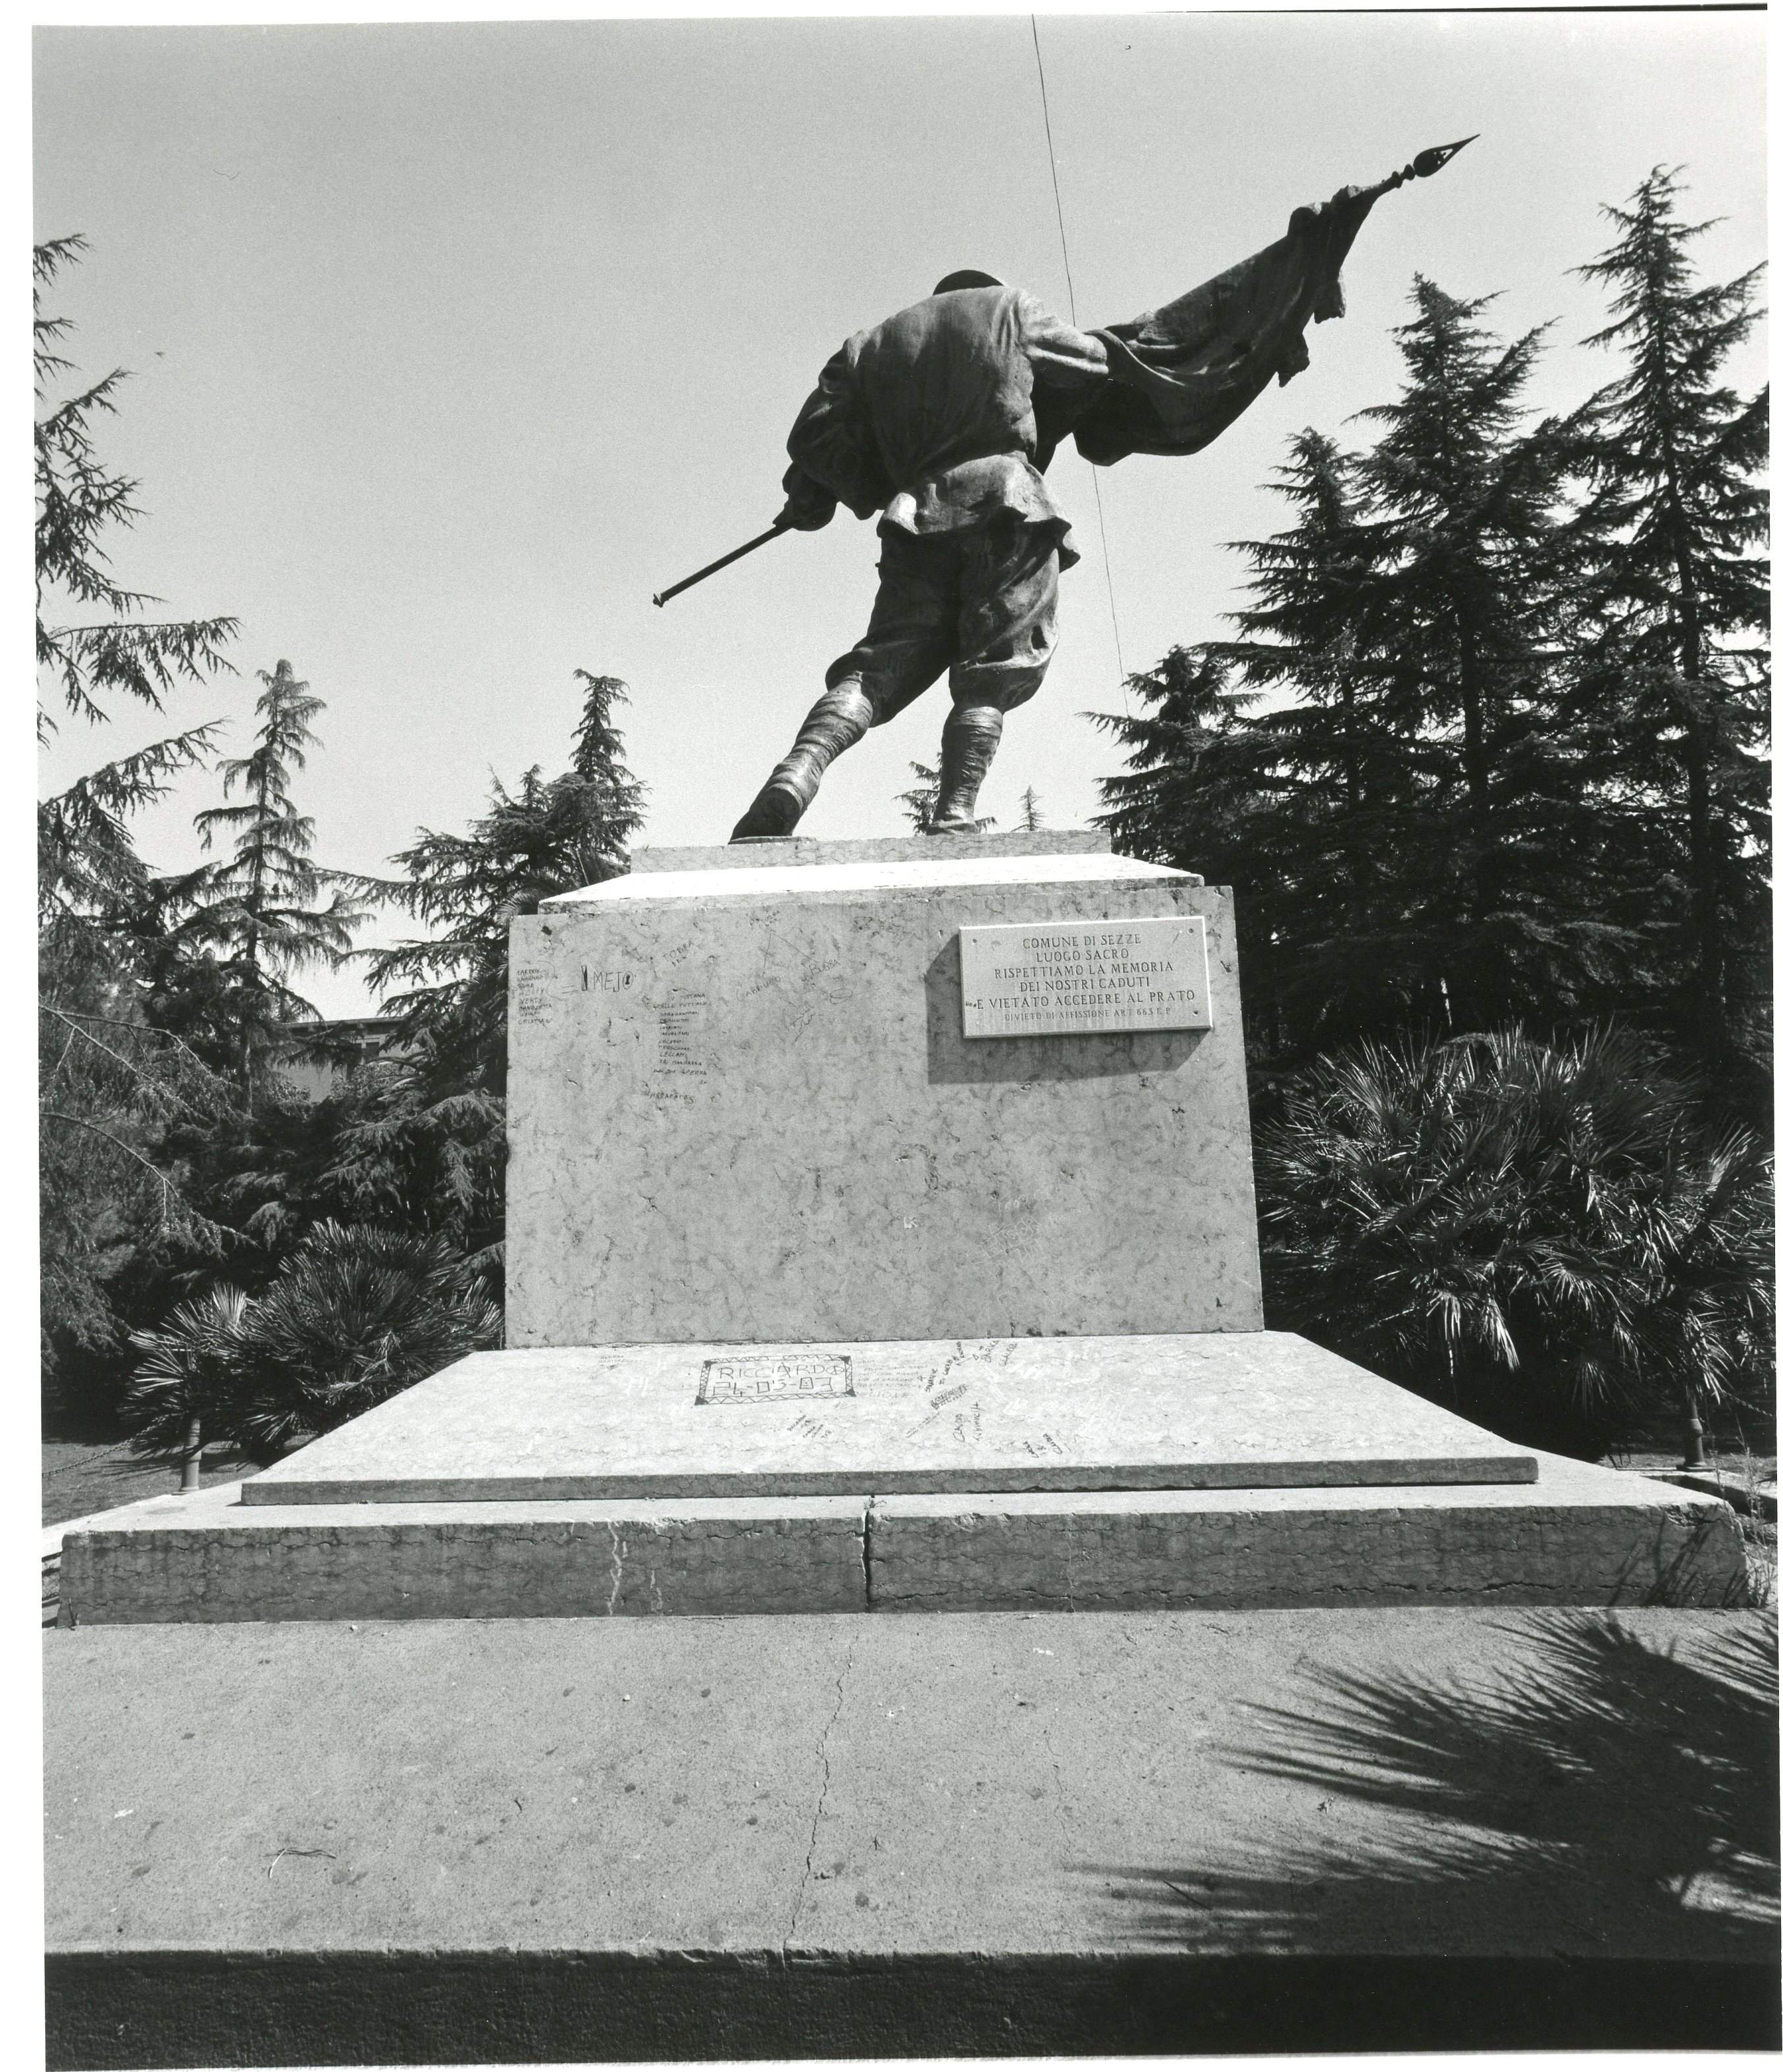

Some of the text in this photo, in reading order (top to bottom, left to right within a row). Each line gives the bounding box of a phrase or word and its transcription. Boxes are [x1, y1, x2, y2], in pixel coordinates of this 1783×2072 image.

[1023, 933, 1141, 949] COMUNE DI SEZZE
[1036, 948, 1129, 963] LUOGO SACRO
[995, 961, 1173, 979] RISPETTIAMO LA MEMORIA
[1020, 976, 1150, 993] DEI NOSTRI CADUTI
[977, 989, 1195, 1010] E VIETATO ACCEDERE AL PRATO
[1004, 1006, 1172, 1022] DIVIETO DI AFFISSIONE ART 663 C P
